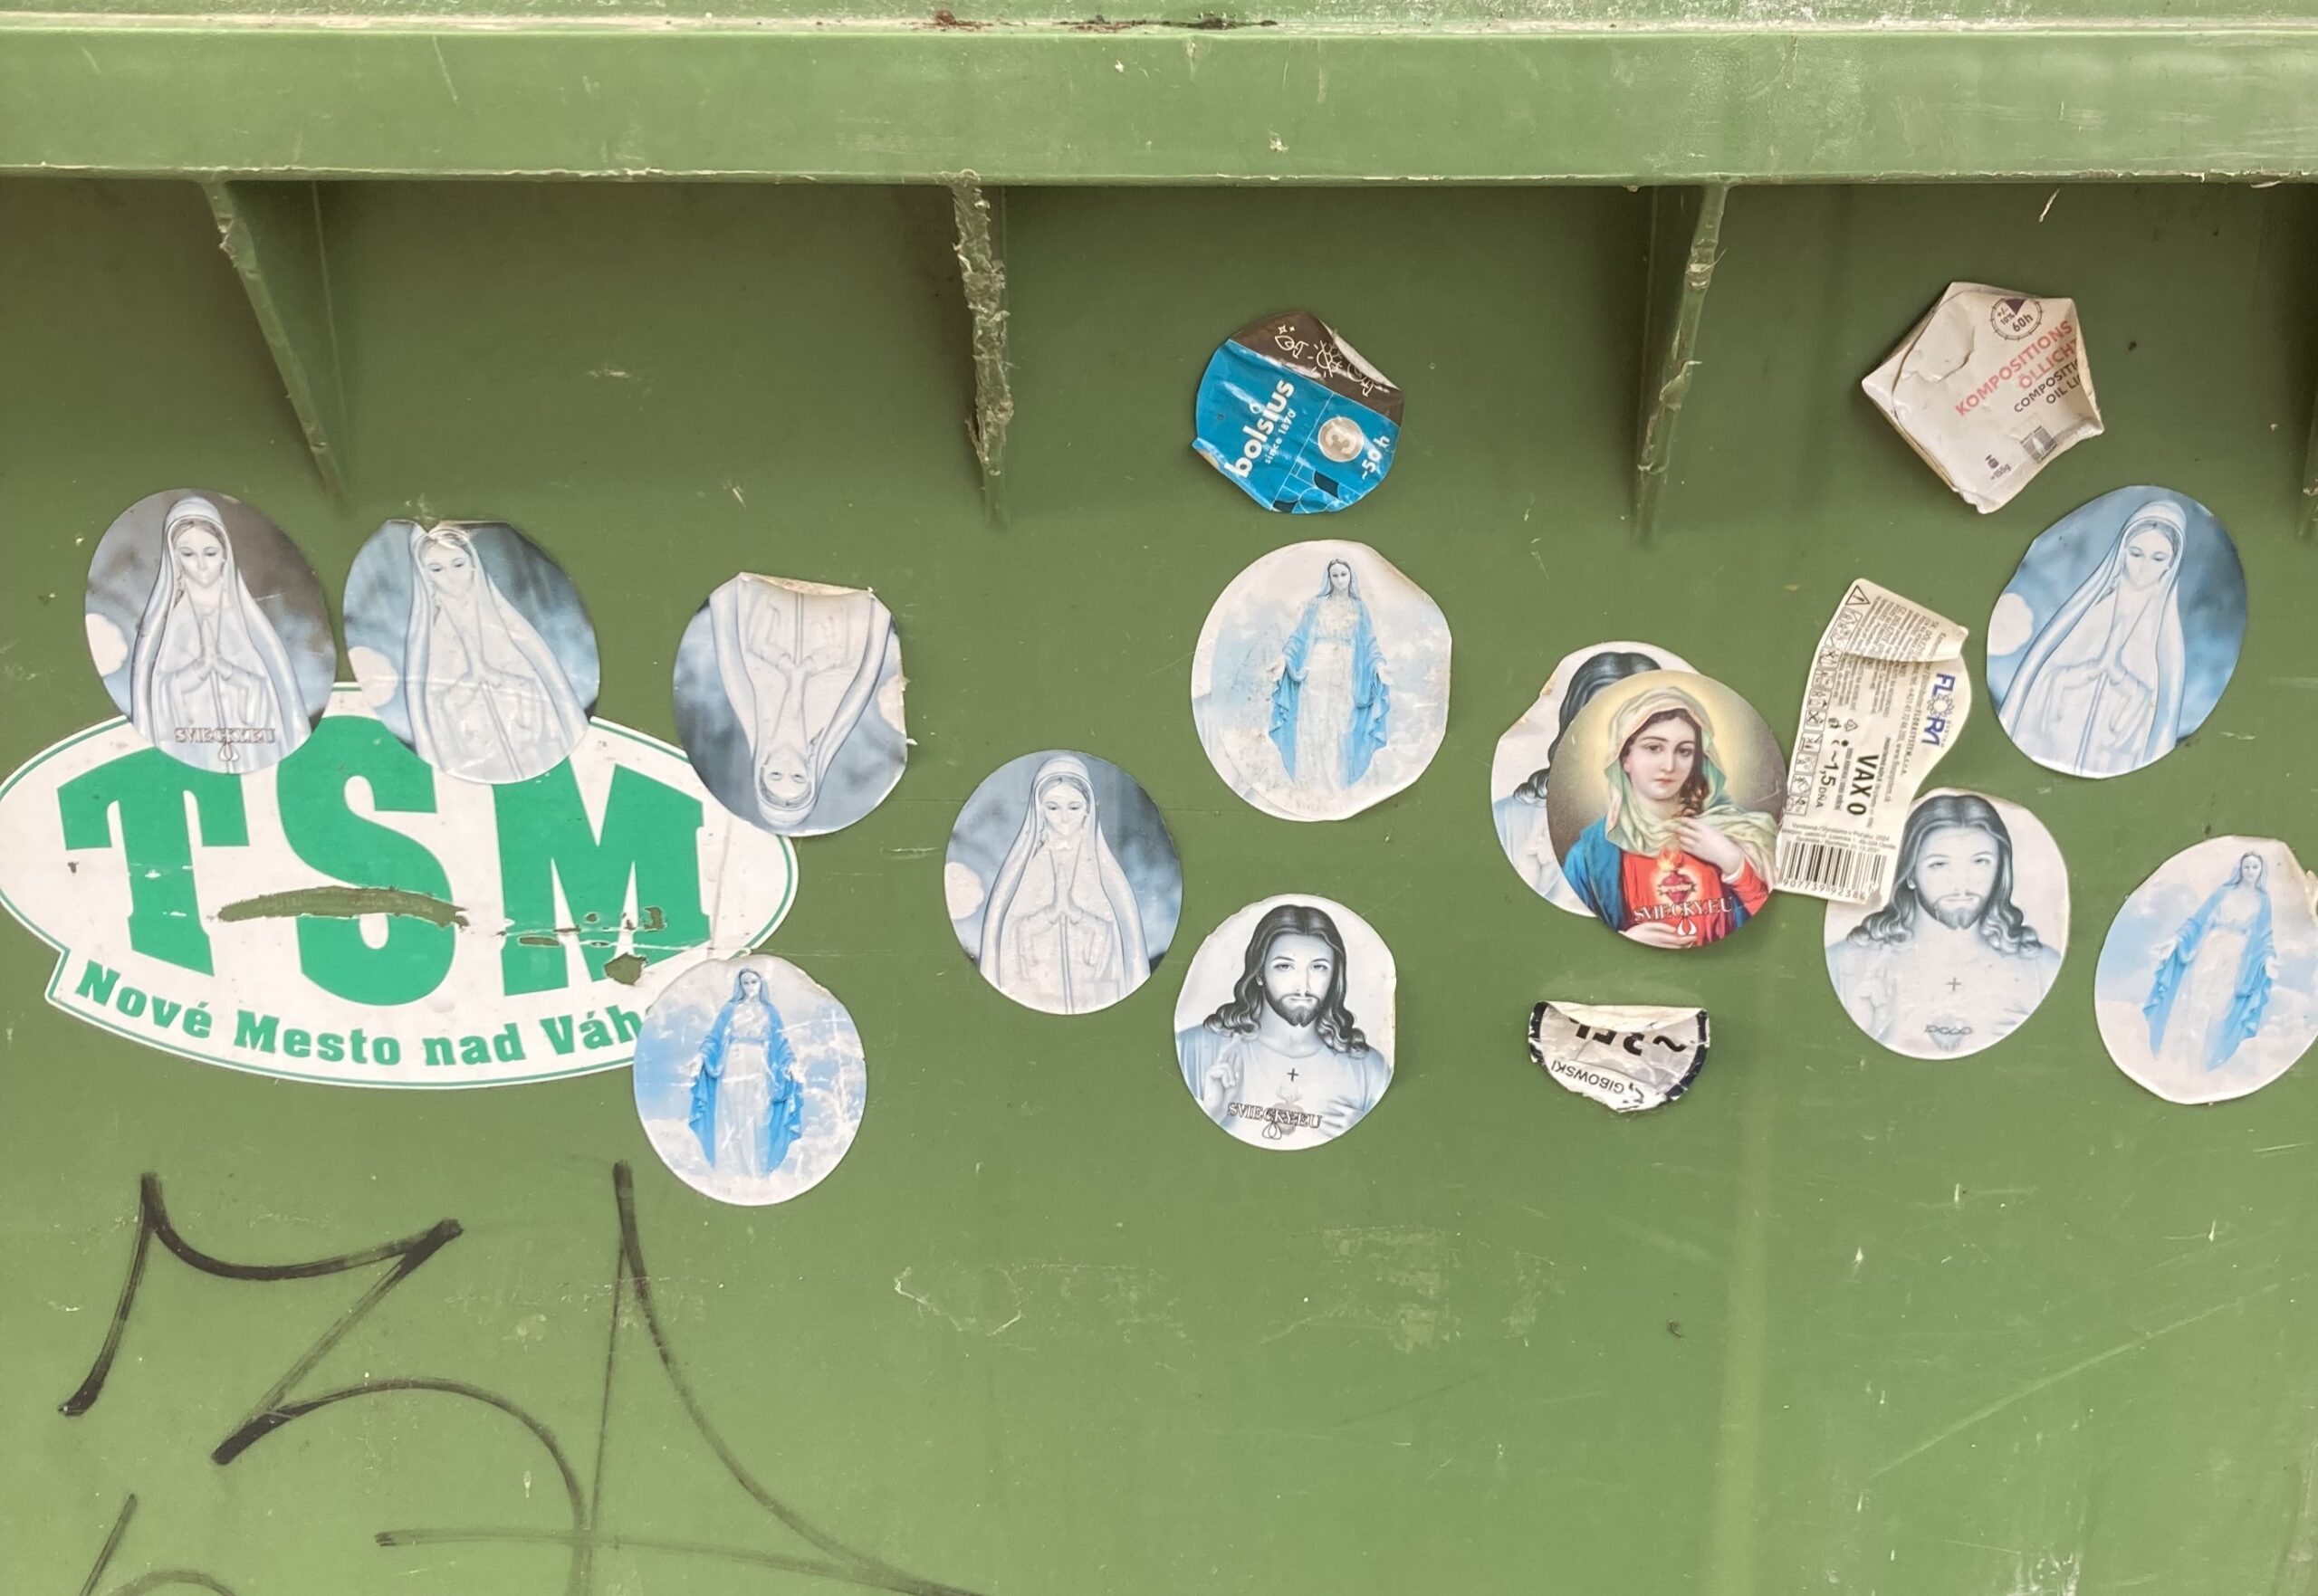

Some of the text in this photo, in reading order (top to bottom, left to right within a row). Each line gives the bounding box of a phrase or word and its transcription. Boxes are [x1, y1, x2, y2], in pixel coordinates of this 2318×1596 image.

[2012, 314, 2034, 332] 60h
[1955, 320, 2073, 416] KOMPOSITIONS
[2046, 386, 2067, 405] OIL
[1224, 379, 1295, 478] bolsius
[1265, 410, 1297, 464] since 1870
[1850, 756, 1879, 798] VAX
[56, 714, 713, 1007] TSM
[74, 960, 650, 1066] Nové Mesto nad Váh
[1551, 1060, 1625, 1094] GIBOWSKI
